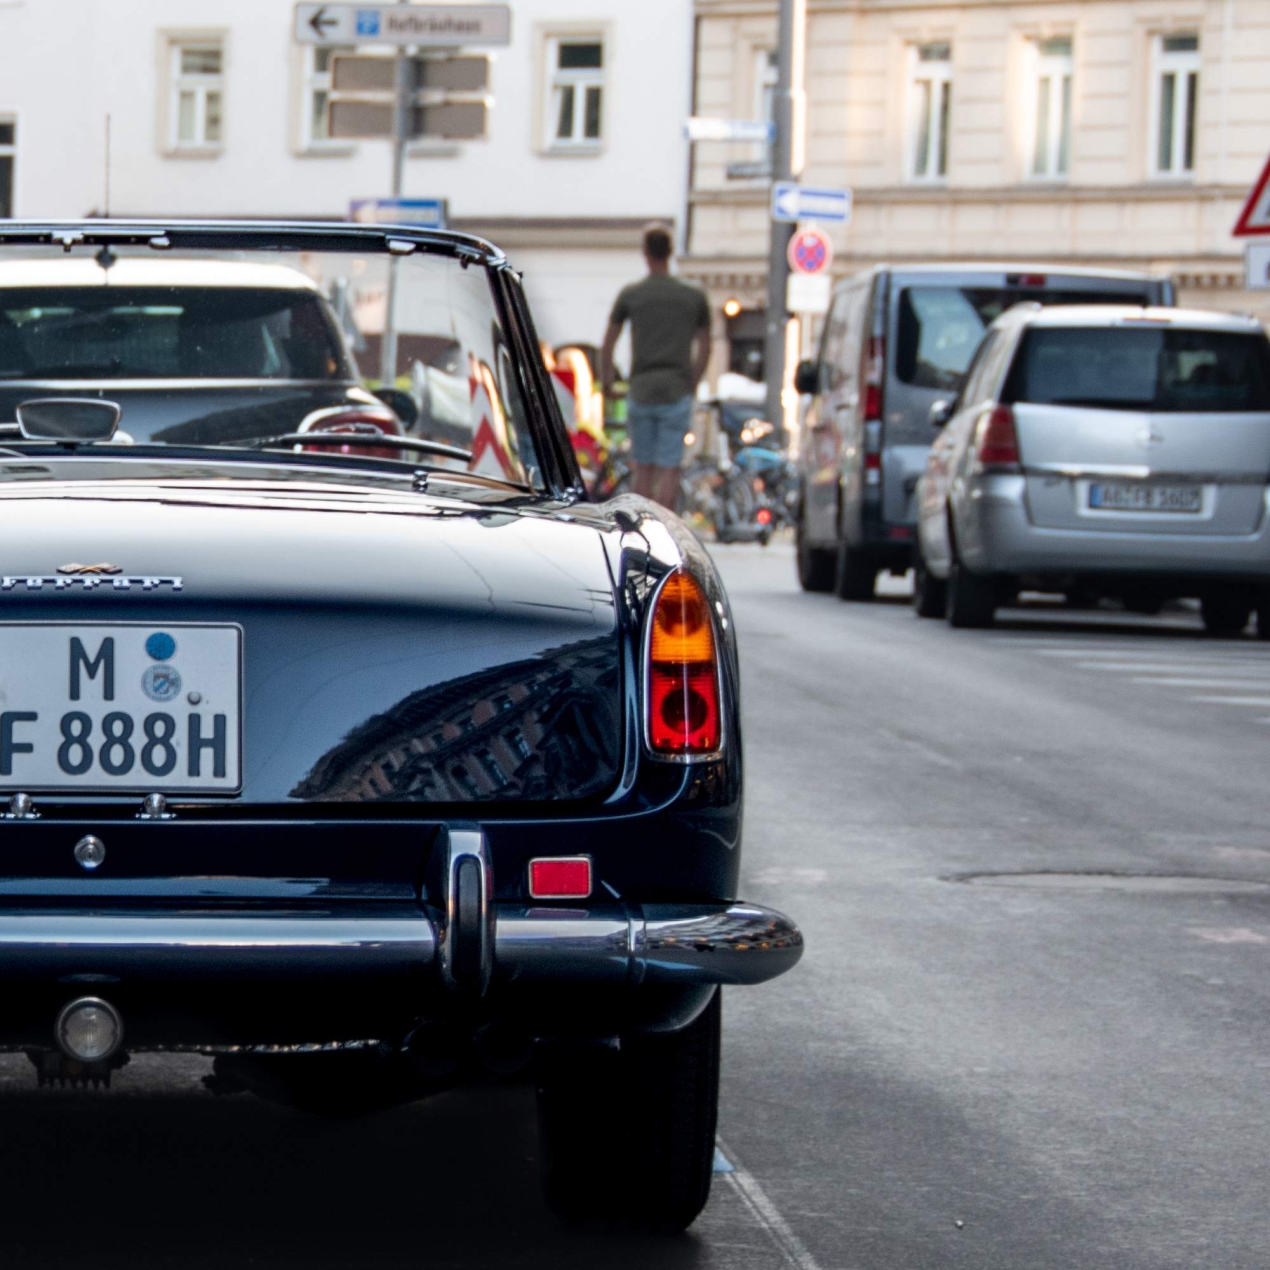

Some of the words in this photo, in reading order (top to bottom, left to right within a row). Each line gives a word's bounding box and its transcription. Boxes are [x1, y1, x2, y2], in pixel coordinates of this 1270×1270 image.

[1, 575, 184, 590] Ferrari
[69, 636, 115, 701] M
[57, 711, 227, 778] 888H
